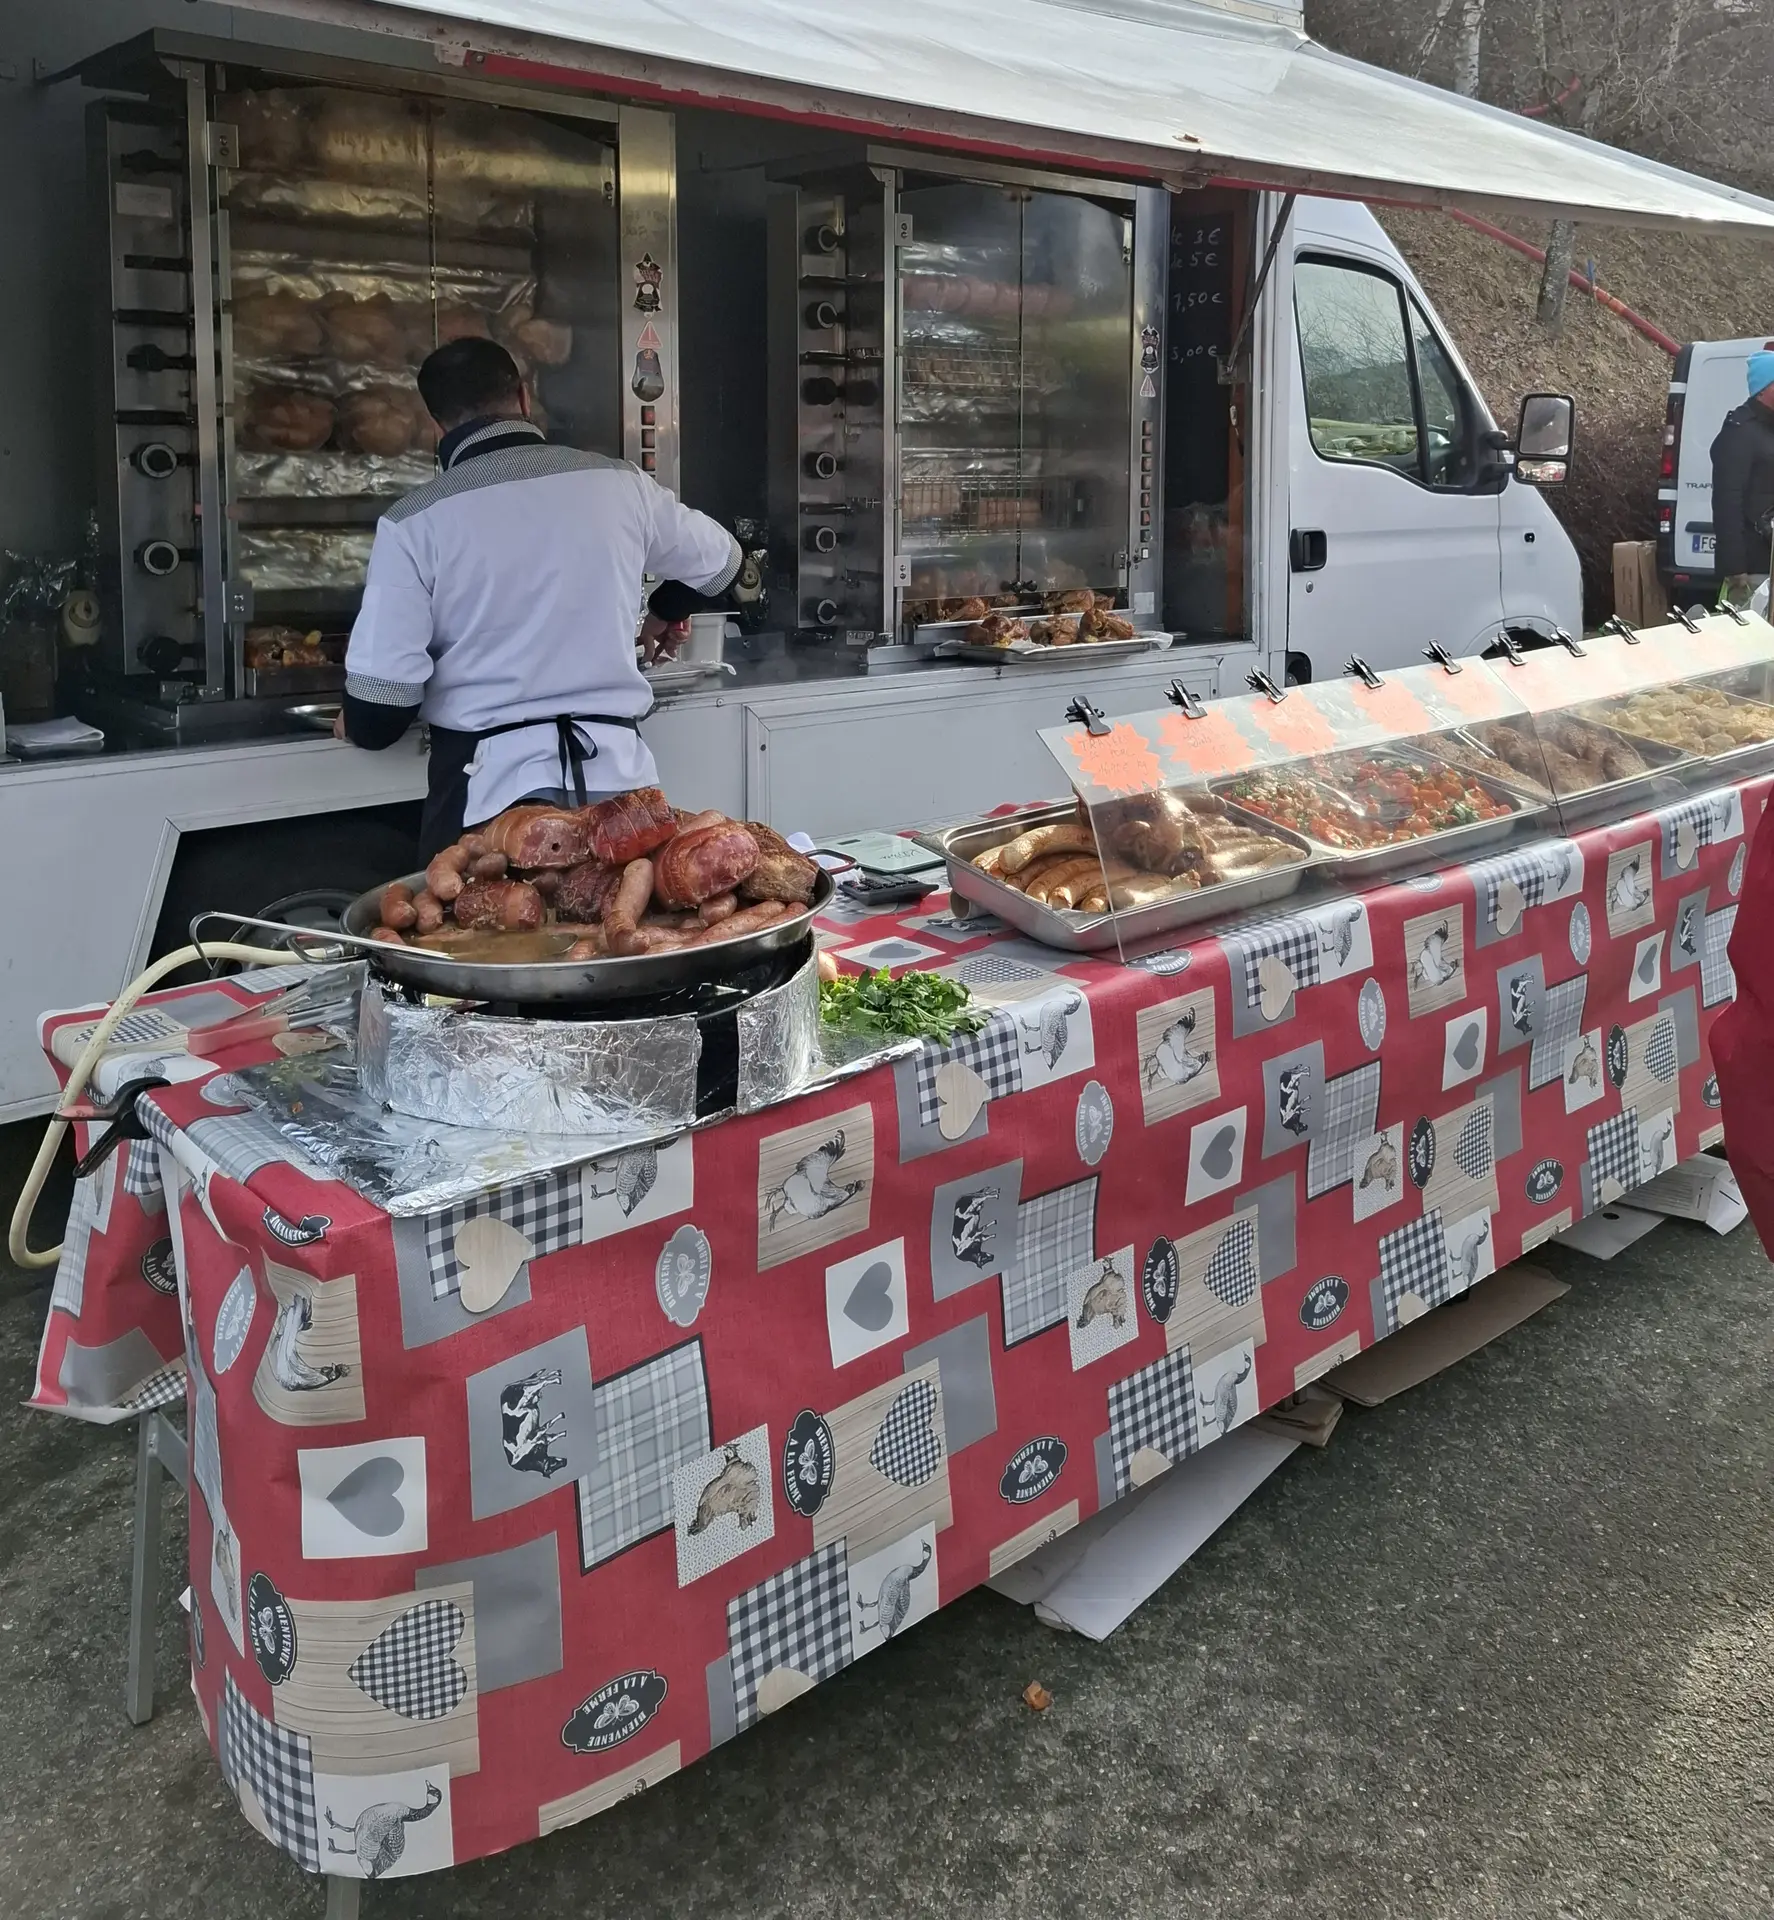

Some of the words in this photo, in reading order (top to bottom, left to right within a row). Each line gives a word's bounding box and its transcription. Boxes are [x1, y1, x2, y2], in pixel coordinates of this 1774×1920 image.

[661, 1252, 676, 1308] BIENVENUE
[787, 1451, 797, 1466] LA
[815, 1426, 831, 1487] BIENVENUE
[787, 1469, 802, 1504] FERME
[1015, 1470, 1055, 1499] BIENVENUE
[275, 1605, 292, 1668] BIENVENUE
[581, 1682, 619, 1715] FERME
[623, 1675, 637, 1689] LA
[587, 1710, 647, 1748] BIENVENUE
